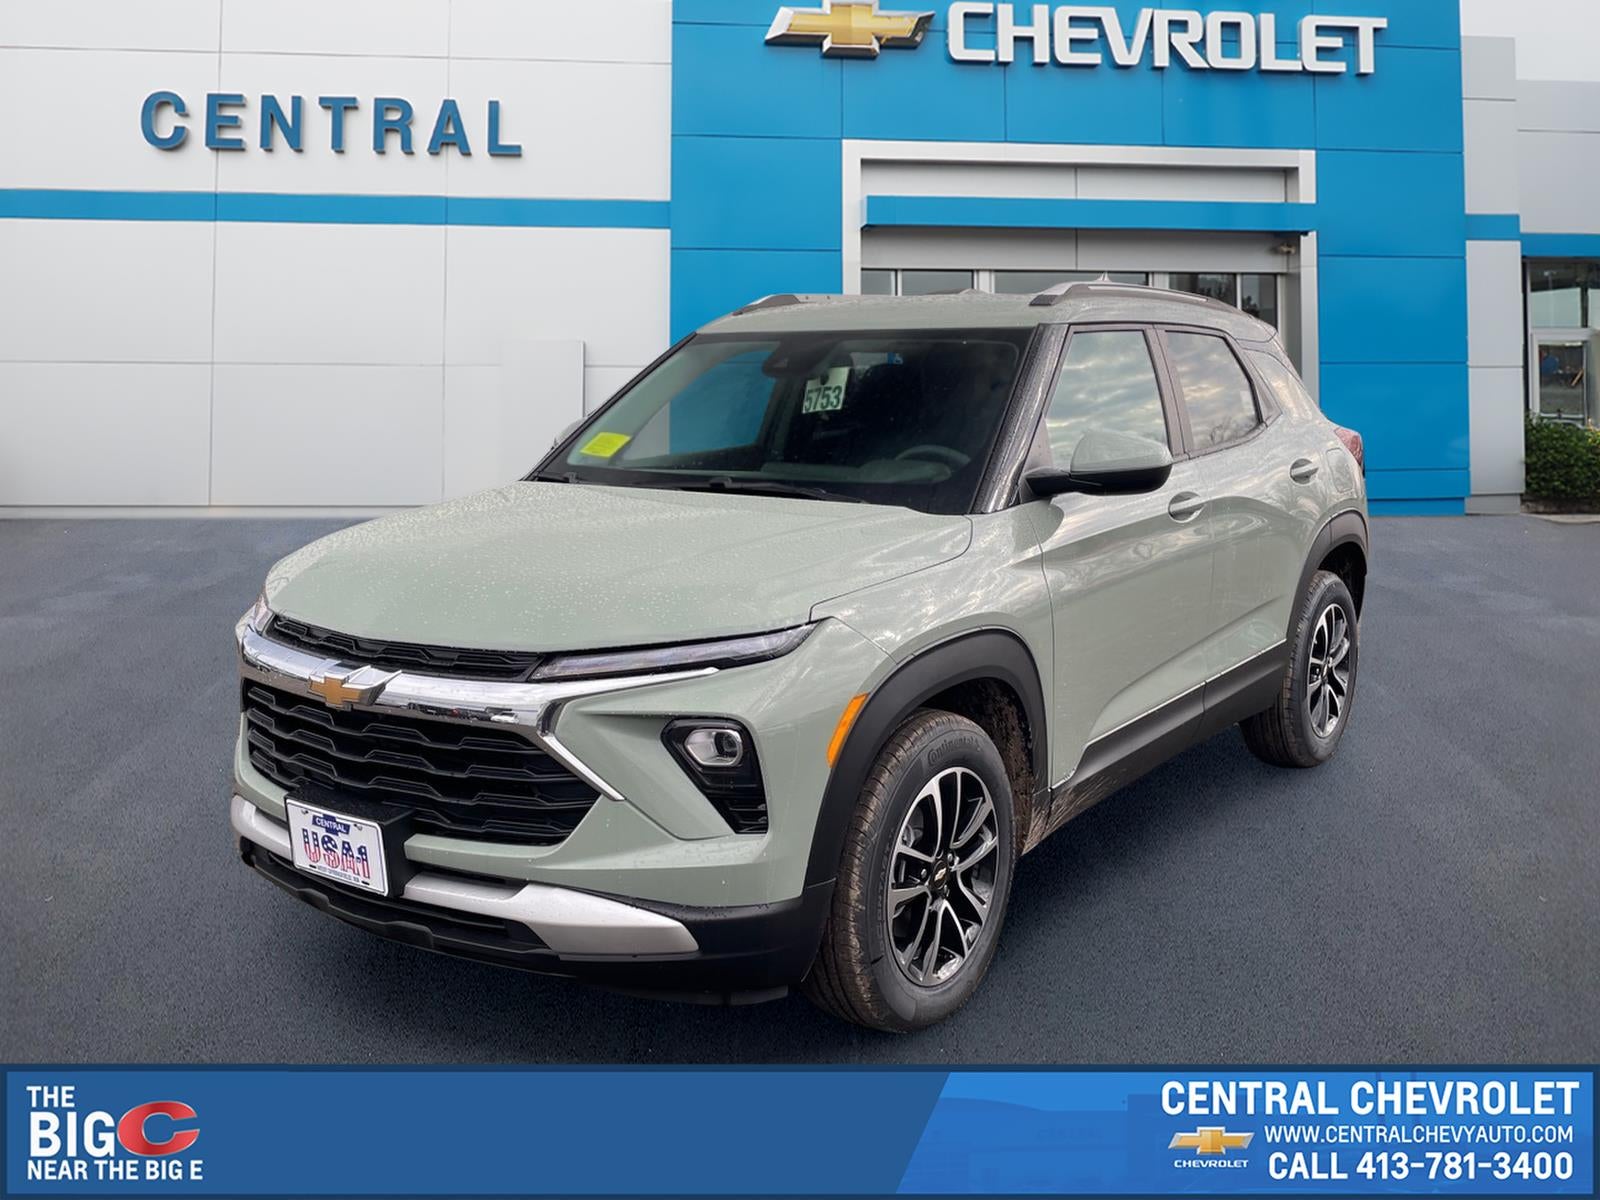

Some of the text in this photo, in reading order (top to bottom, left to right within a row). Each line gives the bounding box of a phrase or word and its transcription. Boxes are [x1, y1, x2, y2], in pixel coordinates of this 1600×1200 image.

[945, 0, 1388, 75] CHEVROLET
[140, 90, 522, 158] CENTRAL
[804, 384, 843, 411] 5753
[315, 817, 347, 833] CENTRAL
